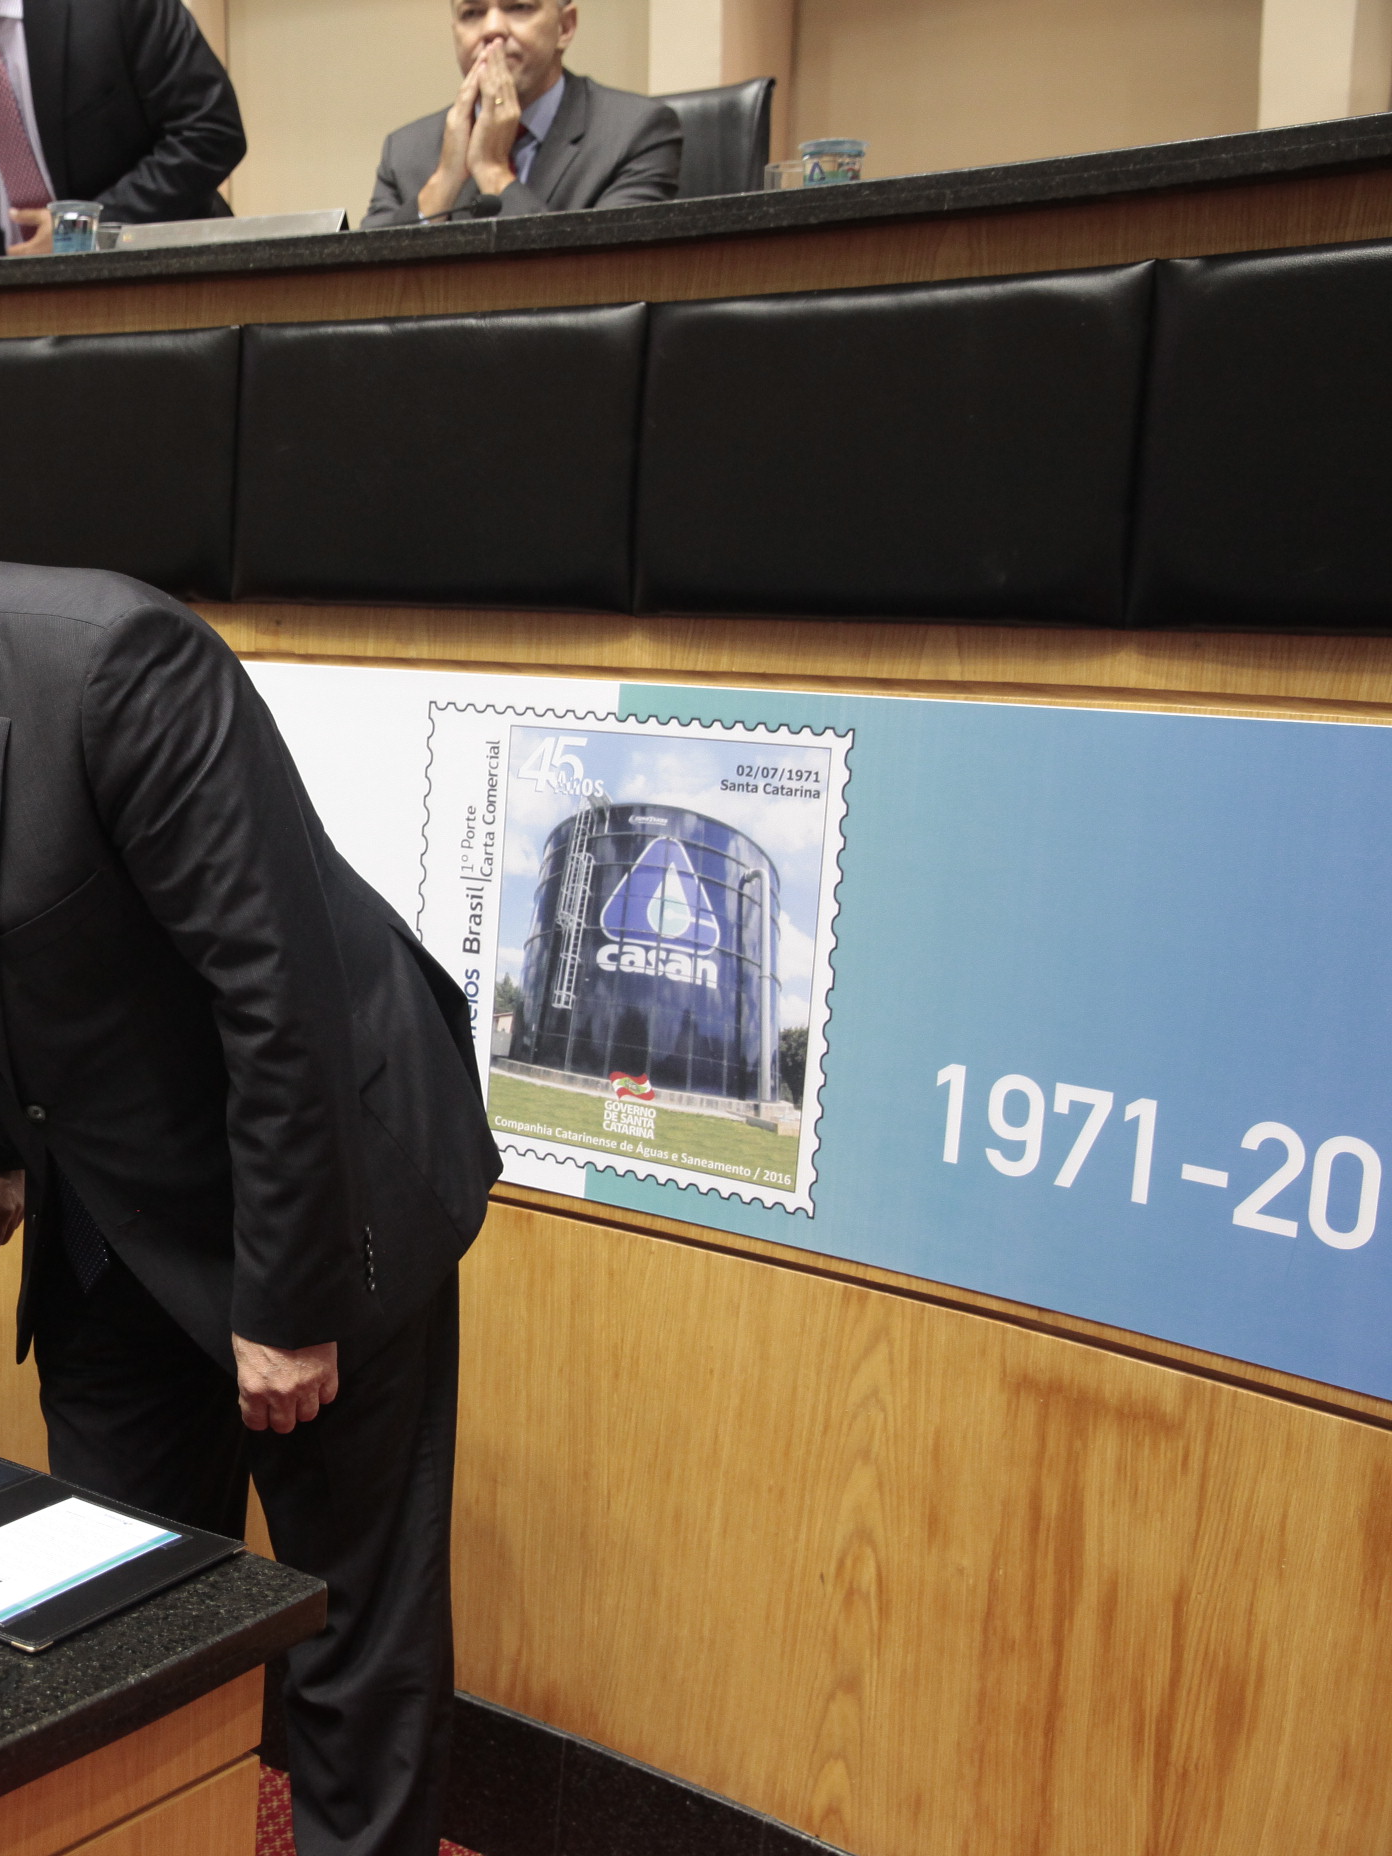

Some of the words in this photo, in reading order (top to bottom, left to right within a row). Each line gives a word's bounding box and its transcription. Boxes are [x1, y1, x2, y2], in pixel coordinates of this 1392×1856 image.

[482, 740, 501, 826] Comercial
[516, 735, 588, 793] 45
[736, 764, 821, 783] 02/07/1971
[720, 779, 759, 794] Santa
[763, 783, 821, 799] Catarina
[461, 805, 477, 849] Porte
[480, 831, 496, 878] Carta
[462, 887, 485, 955] Brasil
[596, 943, 718, 989] casan
[602, 1120, 655, 1140] CATARINA
[603, 1110, 619, 1122] DE
[620, 1113, 655, 1130] SANTA
[604, 1100, 657, 1119] GOVERNO
[494, 1115, 553, 1136] Companhia
[555, 1127, 617, 1149] Catarinense
[619, 1140, 634, 1152] de
[636, 1142, 669, 1160] Águas
[671, 1152, 679, 1162] e
[681, 1152, 751, 1177] Saneamento
[762, 1169, 792, 1186] 2016
[936, 1063, 1382, 1250] 1971-20
